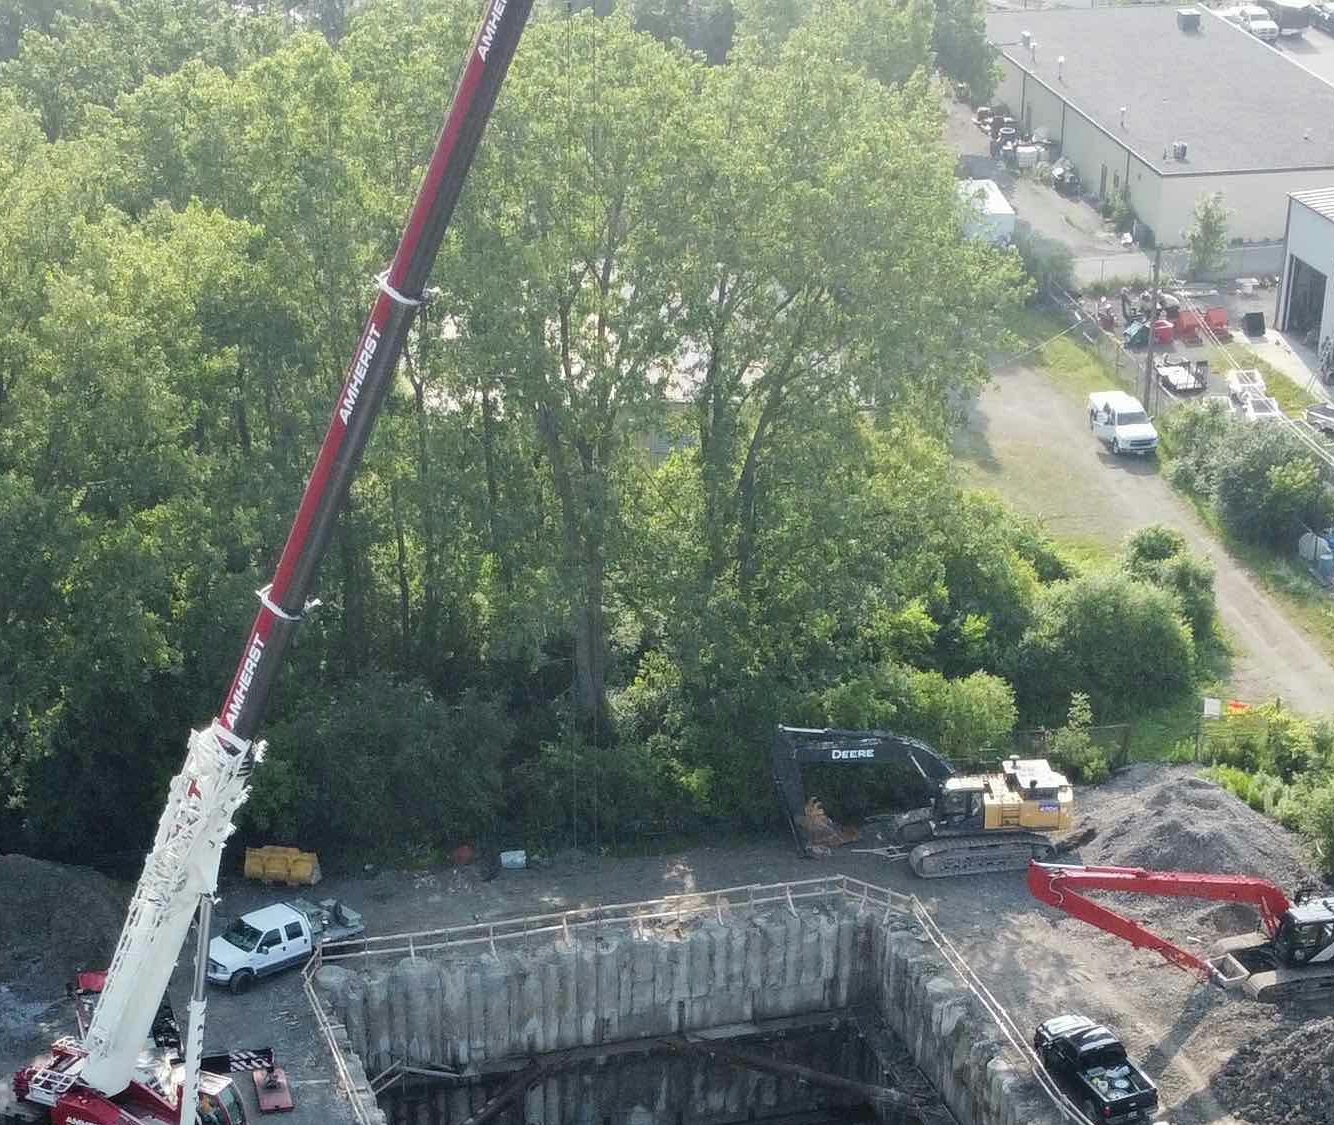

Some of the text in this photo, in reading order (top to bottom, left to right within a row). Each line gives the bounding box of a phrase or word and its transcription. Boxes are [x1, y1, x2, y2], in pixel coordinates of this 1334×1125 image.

[477, 0, 507, 62] AMHE
[340, 322, 381, 426] AMHERST
[226, 631, 265, 730] AMHERST
[832, 749, 875, 760] DEERE
